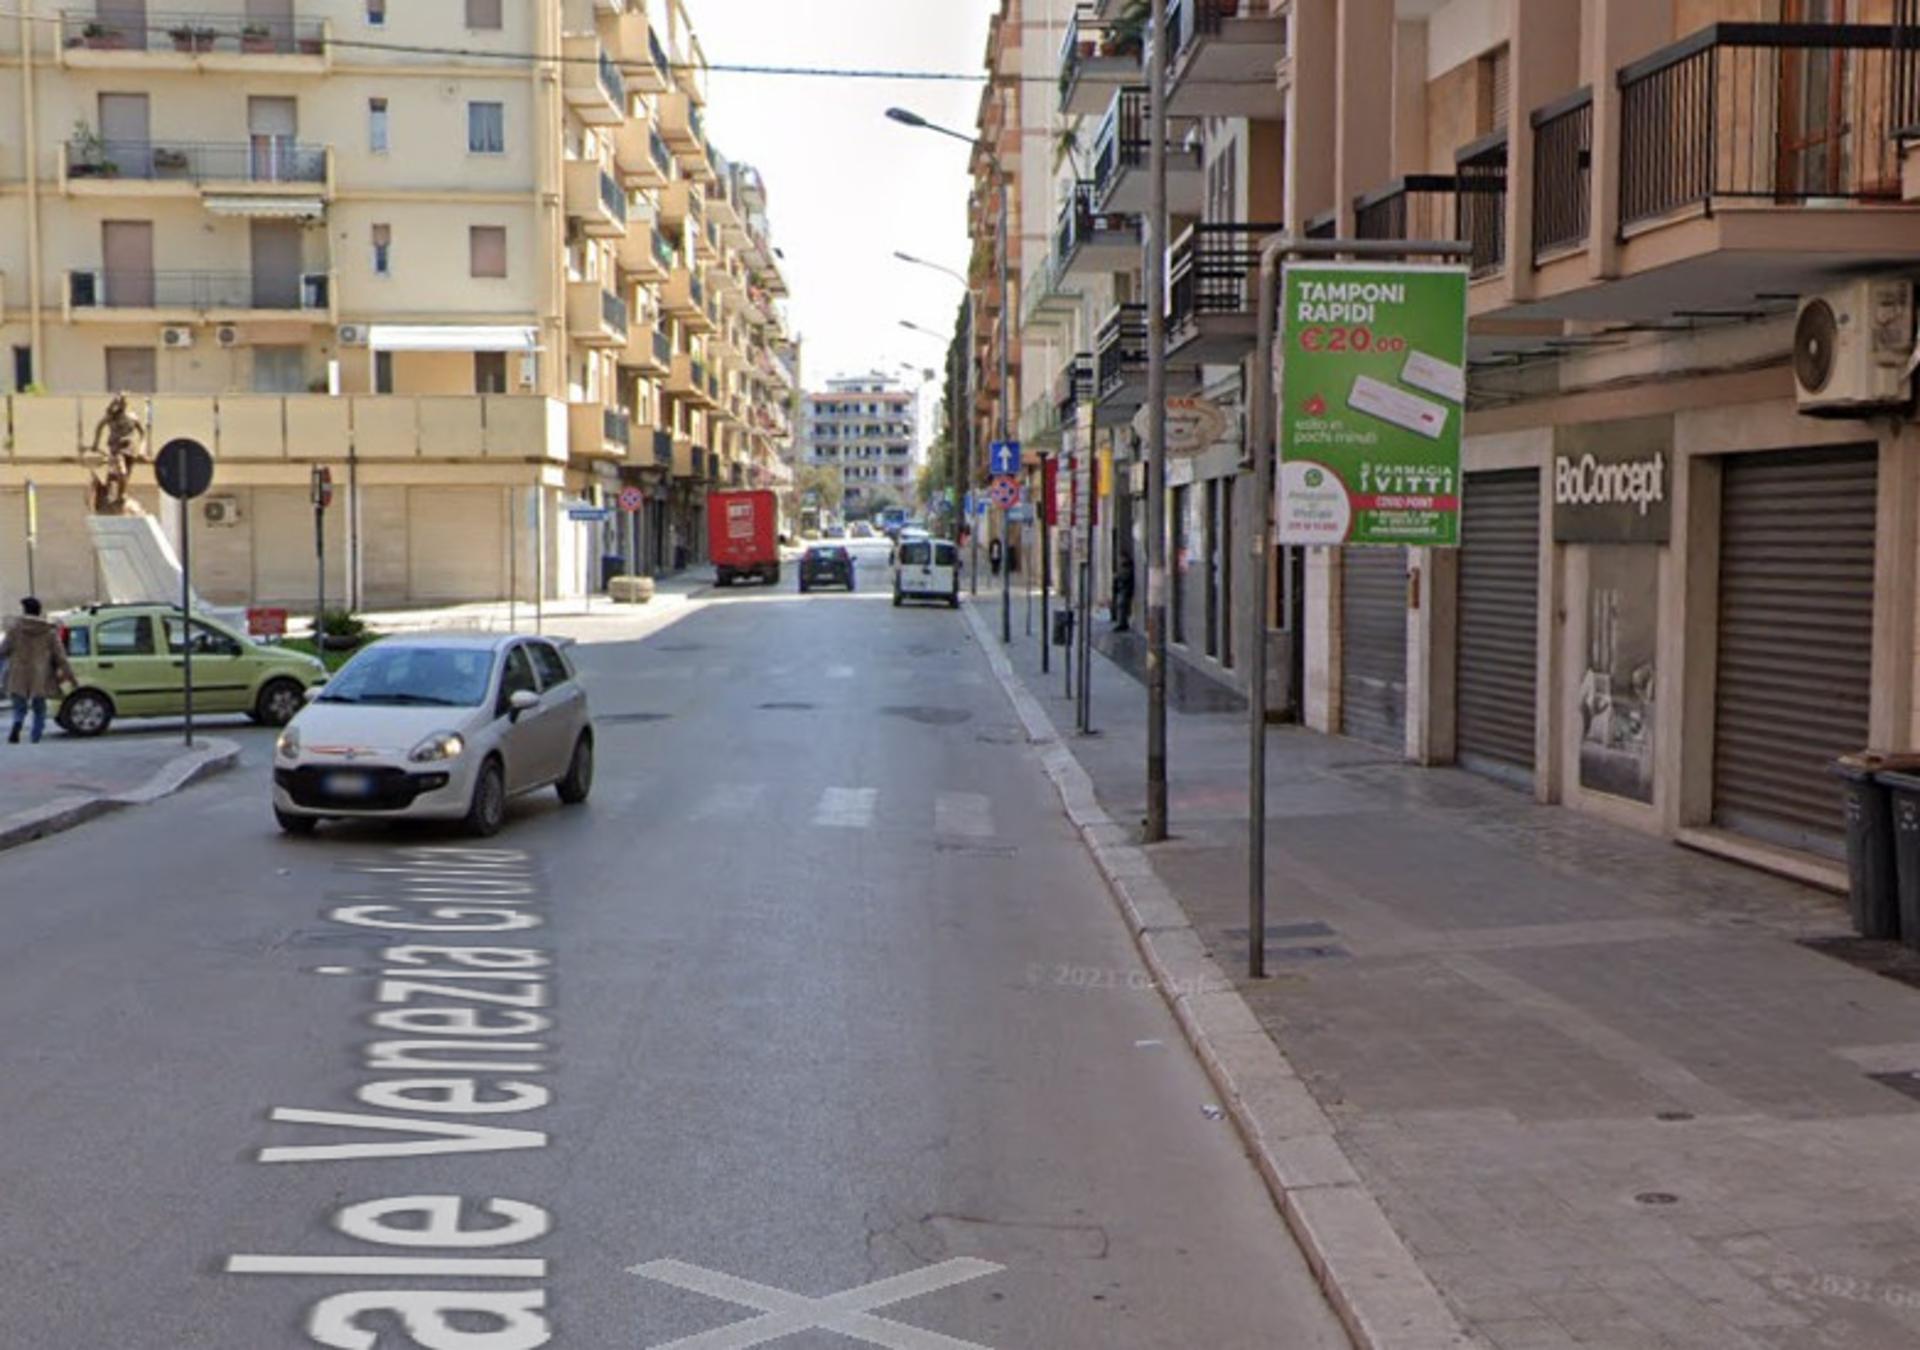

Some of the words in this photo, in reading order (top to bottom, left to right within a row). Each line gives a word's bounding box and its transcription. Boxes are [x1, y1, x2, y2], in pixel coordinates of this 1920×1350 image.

[1298, 281, 1405, 303] TAMPONI
[1298, 303, 1374, 323] RAPIDI
[1294, 430, 1333, 445] pochi
[1374, 464, 1452, 475] FARMACIA
[1374, 475, 1452, 494] VITTI
[1556, 450, 1663, 516] BoConcept
